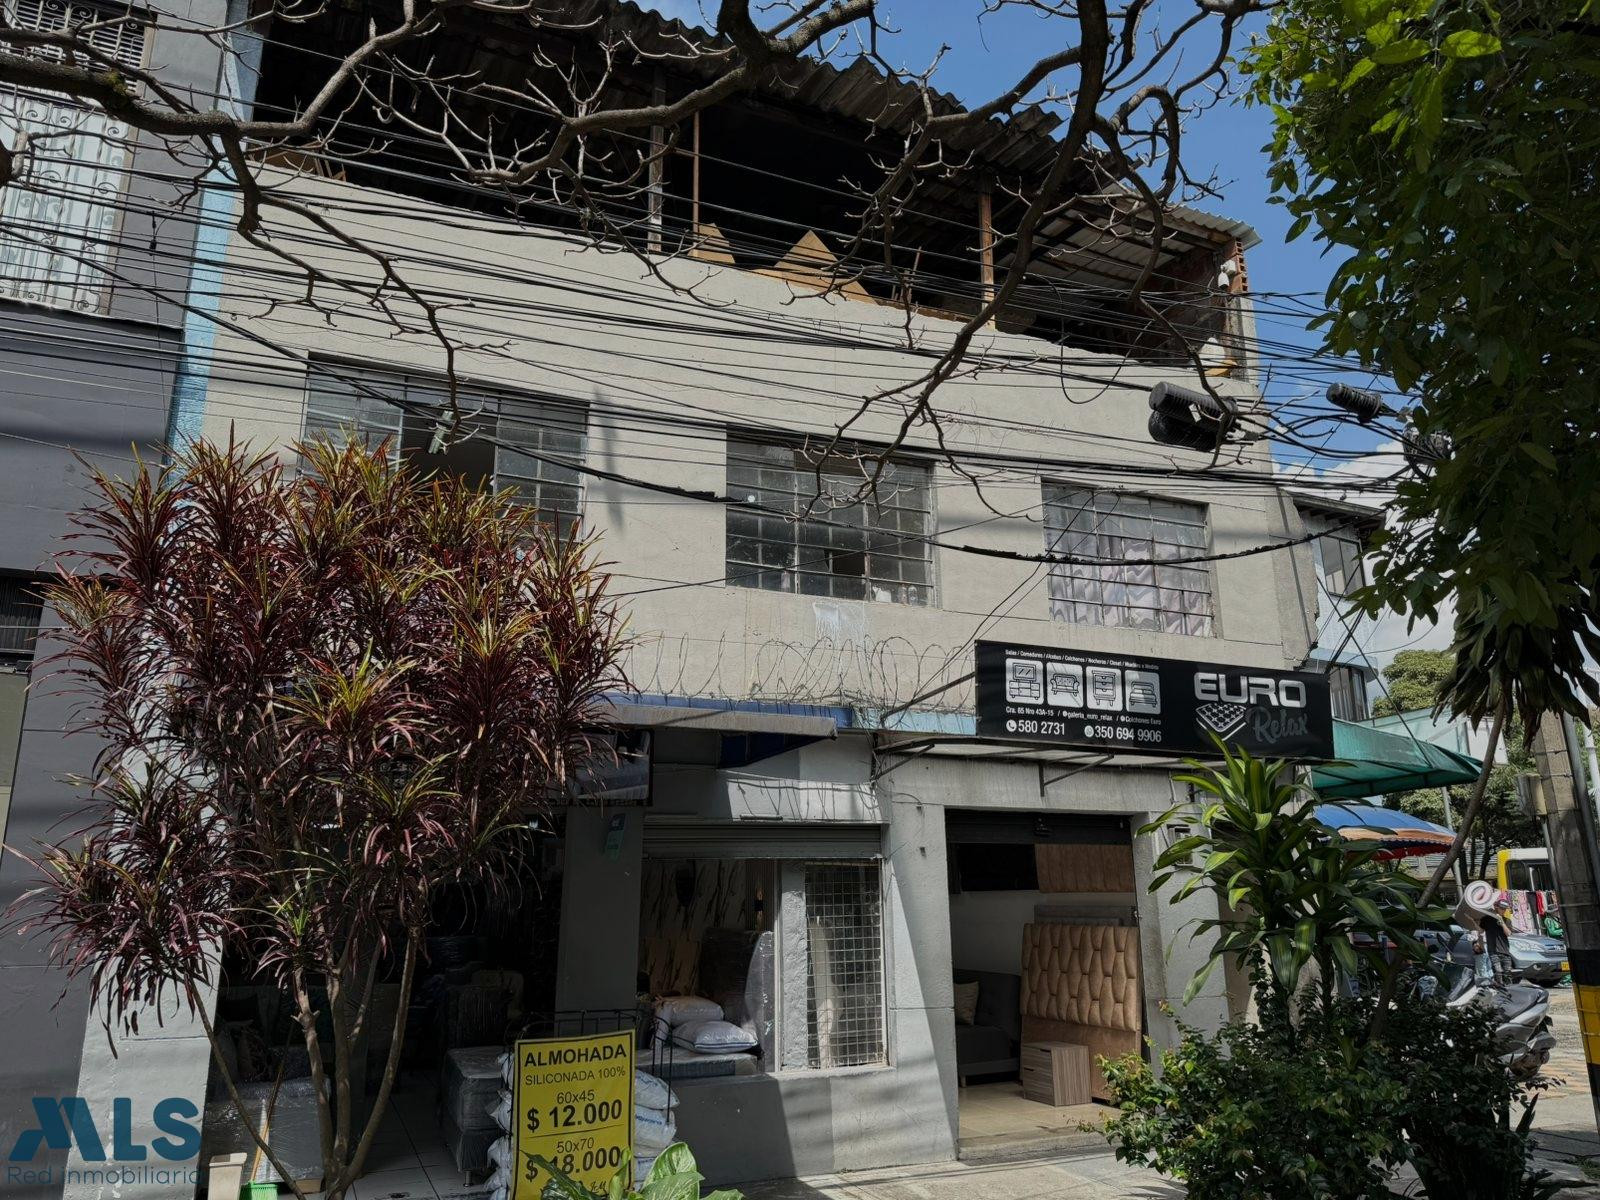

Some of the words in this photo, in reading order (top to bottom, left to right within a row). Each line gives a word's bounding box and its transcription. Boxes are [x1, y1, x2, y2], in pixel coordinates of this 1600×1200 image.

[1193, 672, 1307, 708] EURO
[1018, 719, 1038, 733] 580
[1040, 721, 1065, 735] 2731
[1094, 725, 1114, 739] 350
[1116, 726, 1135, 740] 694
[1137, 728, 1162, 742] 9906
[1246, 706, 1308, 744] Relax
[524, 1043, 627, 1067] ALMOHADA
[525, 1070, 595, 1086] SILICONADA
[598, 1066, 626, 1079] 100%
[556, 1089, 595, 1105] 60x45
[527, 1107, 540, 1132] $
[549, 1099, 622, 1128] 12.000
[556, 1137, 595, 1154] 50x70
[525, 1159, 538, 1182] $
